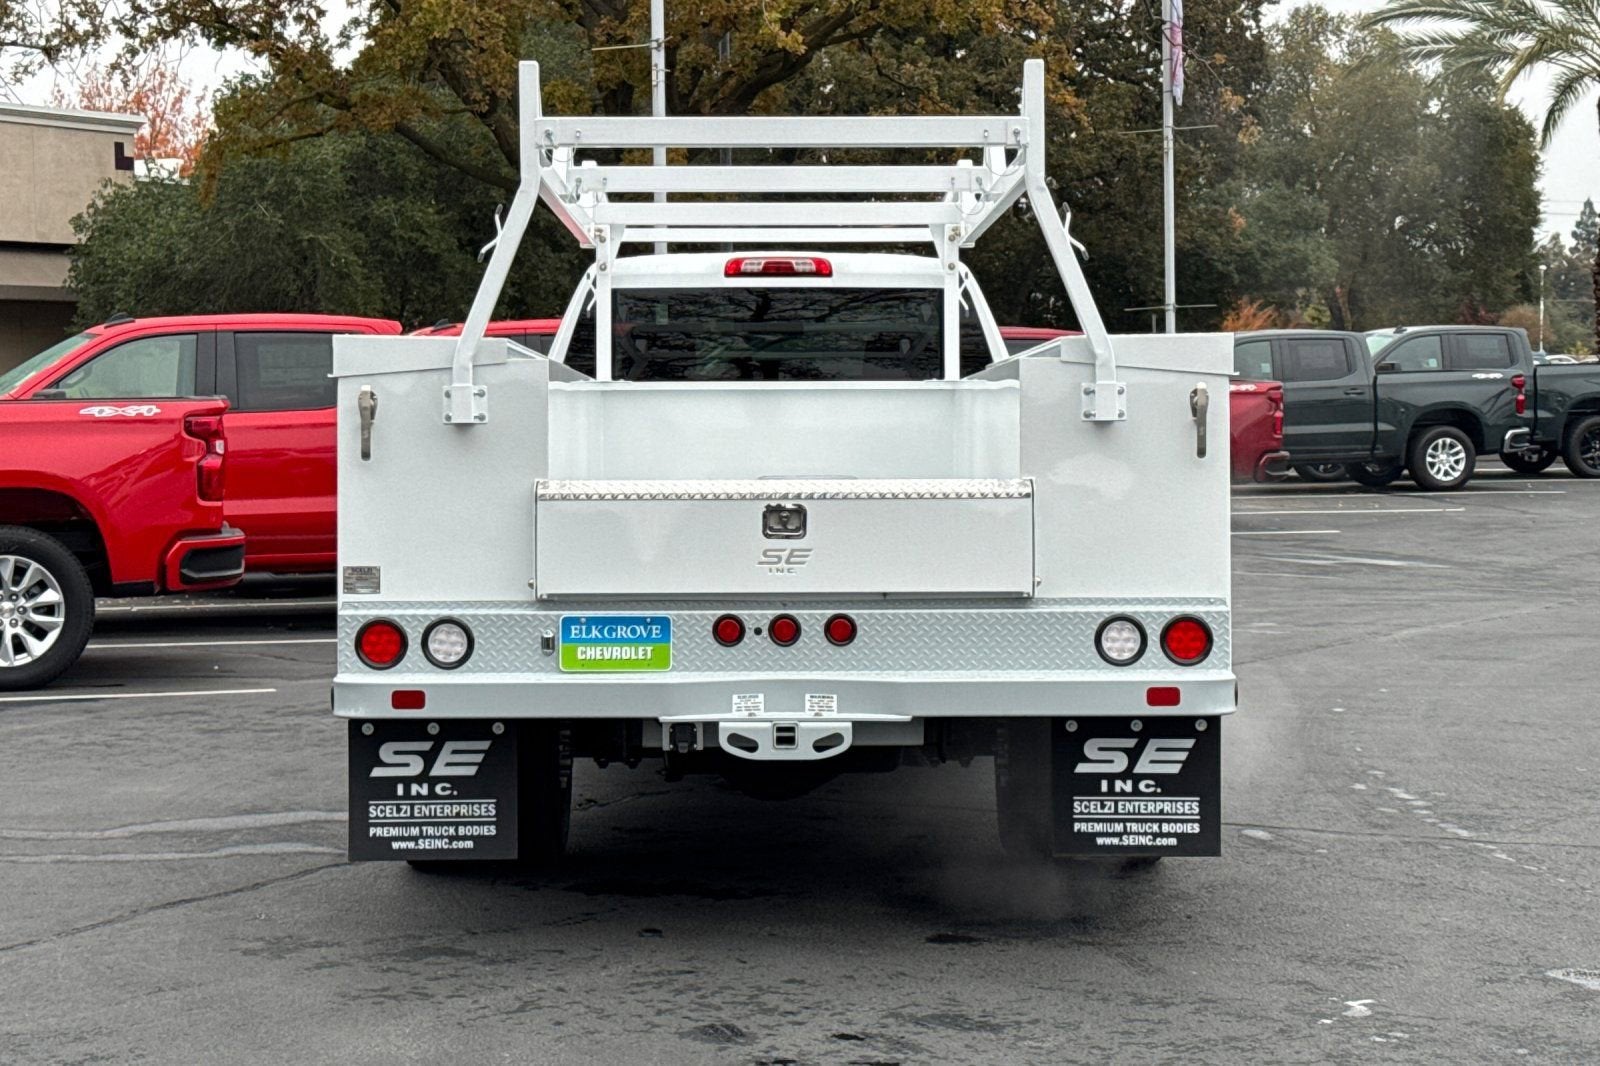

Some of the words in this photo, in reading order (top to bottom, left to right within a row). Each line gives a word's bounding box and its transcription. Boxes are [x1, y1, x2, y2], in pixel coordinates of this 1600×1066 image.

[757, 548, 813, 565] SE
[569, 625, 602, 639] ELK
[604, 625, 662, 639] GROVE
[577, 646, 653, 660] CHEVROLET
[369, 740, 493, 777] SE
[1073, 737, 1197, 774] SE
[397, 783, 458, 797] INC.
[1101, 779, 1162, 793] INC.
[368, 805, 411, 818] SCELZI
[413, 804, 497, 818] ENTERPRISES
[1073, 801, 1115, 814] SCELZI
[1117, 801, 1200, 815] ENTERPRISES
[369, 826, 420, 837] PREMIUM
[422, 826, 456, 837] TRUCK
[458, 825, 497, 836] BODIES
[1073, 822, 1124, 833] PREMIUM
[1126, 823, 1160, 833] TRUCK
[1161, 823, 1200, 834] BODIES
[391, 838, 474, 849] www.SEINC.com
[1095, 835, 1178, 846] www.SEINC.com
